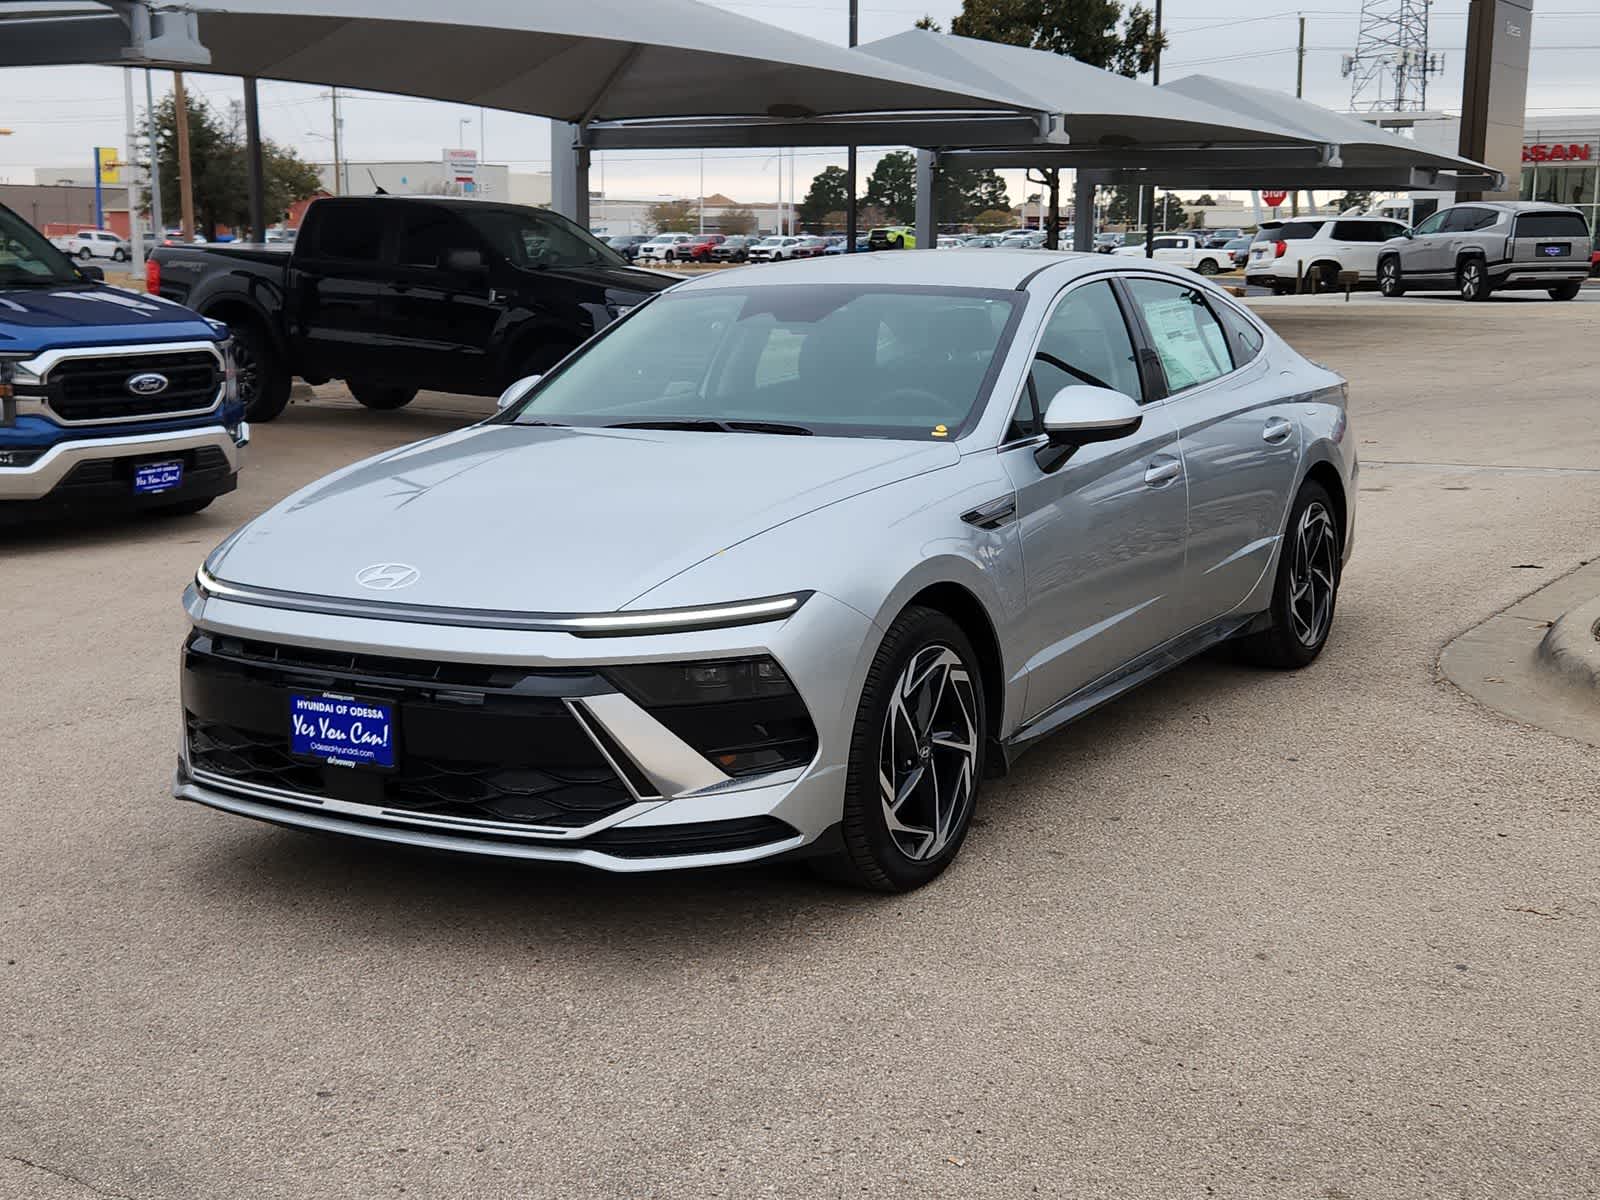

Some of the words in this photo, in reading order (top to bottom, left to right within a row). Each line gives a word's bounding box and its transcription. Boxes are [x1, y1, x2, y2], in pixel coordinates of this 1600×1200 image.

[297, 700, 334, 713] HYUNDAI
[336, 705, 348, 715] OF
[350, 708, 384, 719] ODESSA
[293, 714, 316, 737] Yes
[318, 717, 347, 740] You
[350, 722, 389, 747] Can!
